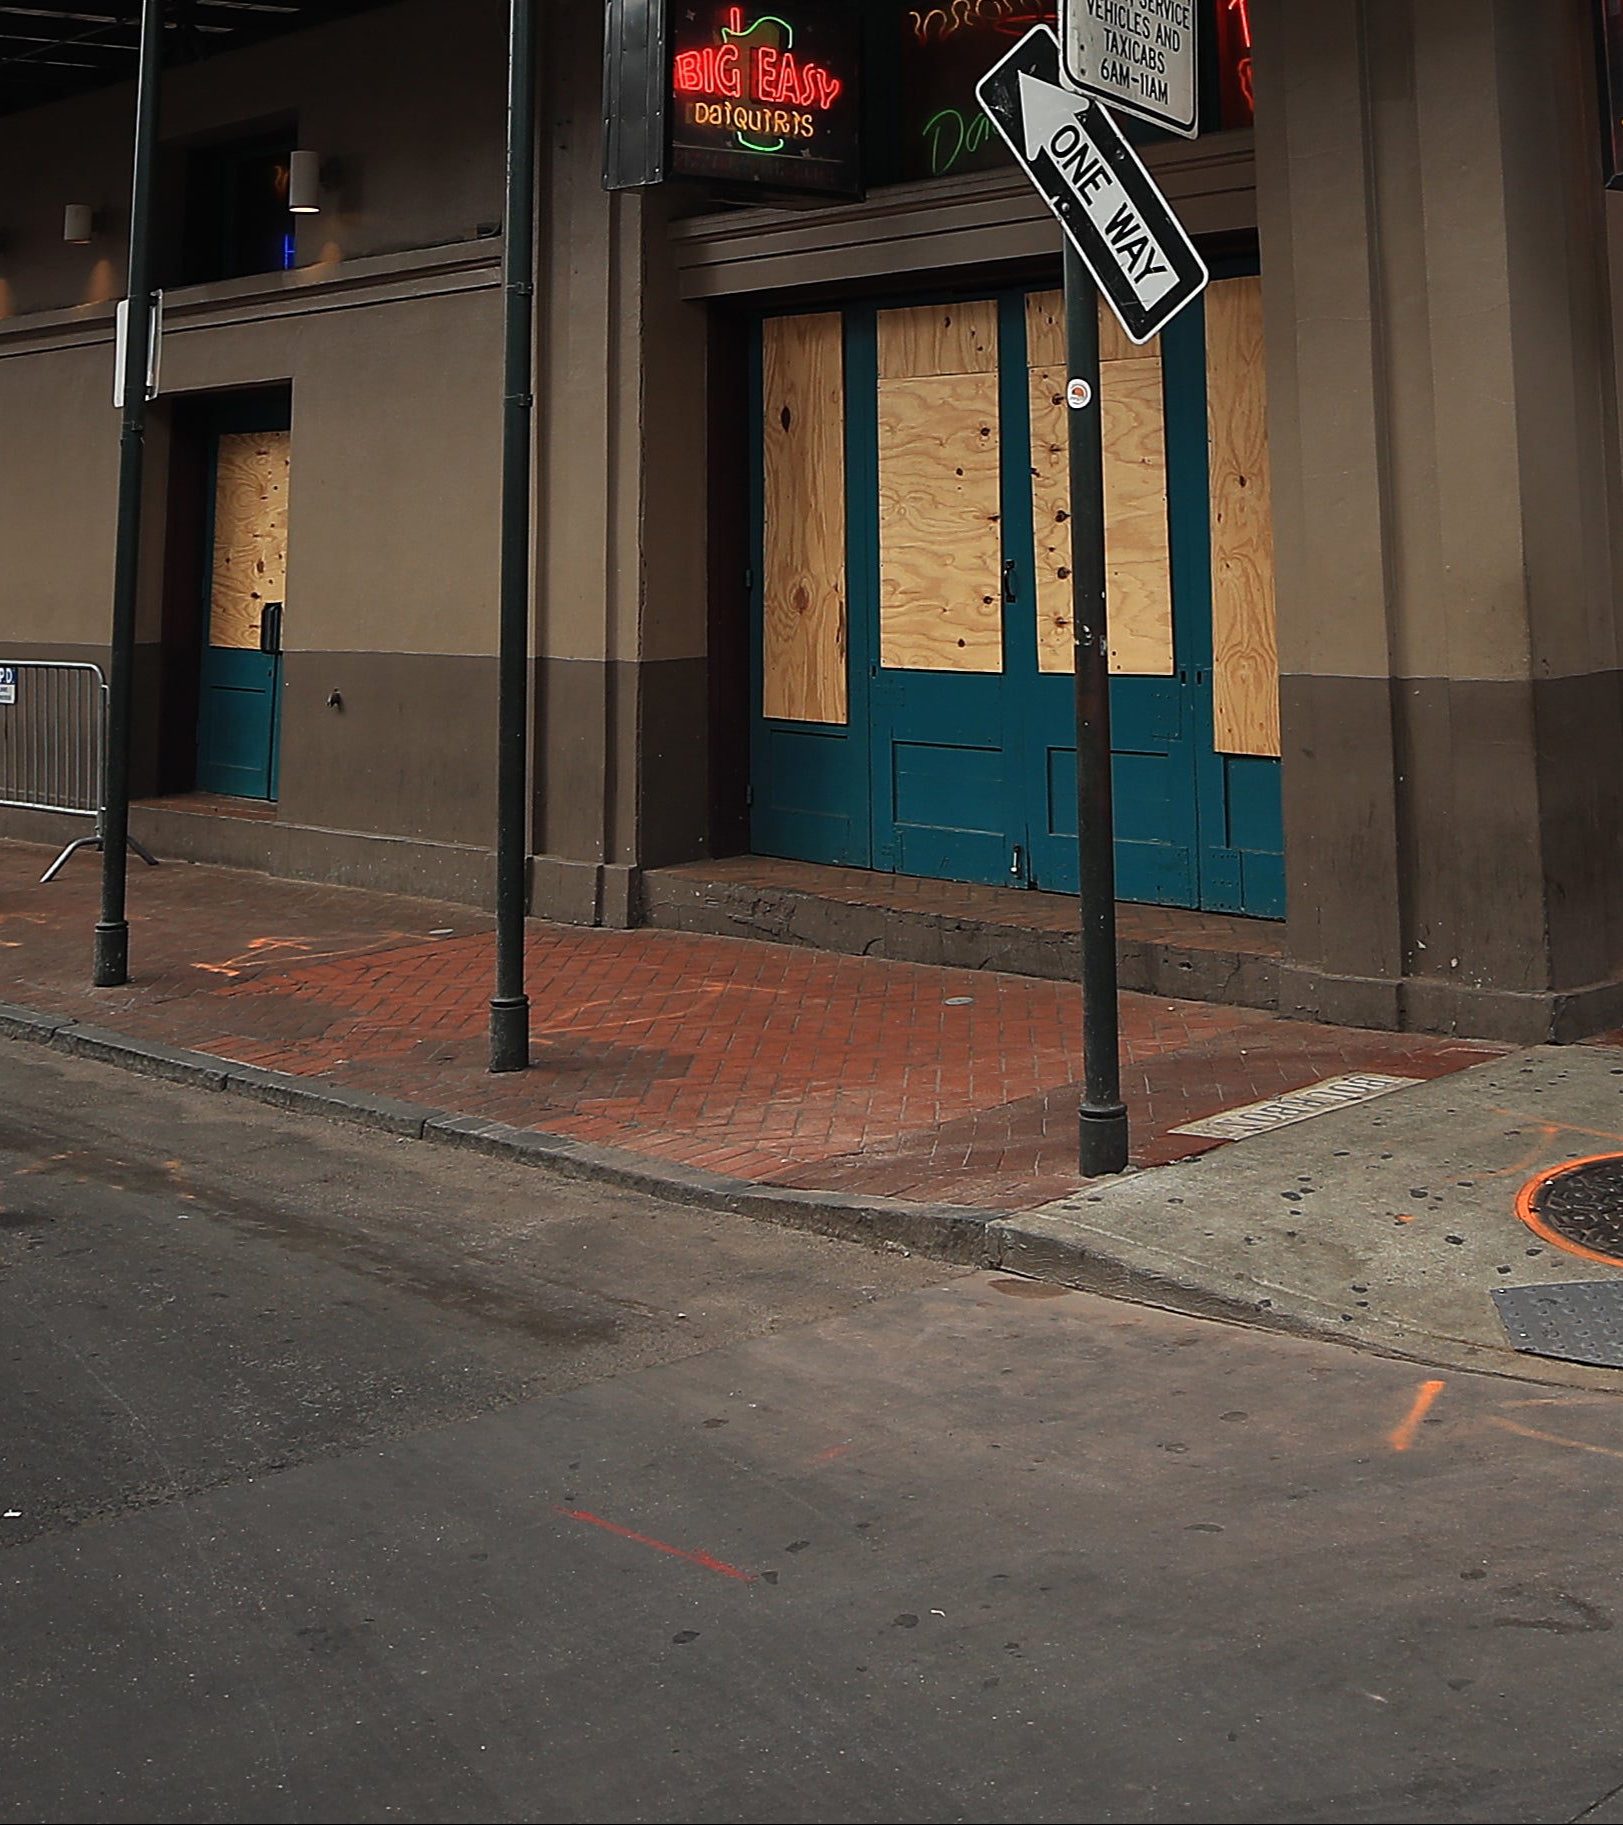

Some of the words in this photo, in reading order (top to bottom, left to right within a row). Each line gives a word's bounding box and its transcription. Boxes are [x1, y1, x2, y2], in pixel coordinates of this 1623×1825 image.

[1104, 27, 1166, 75] TAXICABS
[1154, 23, 1181, 53] AND
[675, 44, 741, 99] BIG
[758, 46, 841, 110] EASY
[1099, 57, 1169, 106] 6AM-11AM
[1050, 124, 1114, 207] ONE
[1104, 201, 1168, 285] WAY
[1212, 1074, 1402, 1133] BOURBON
